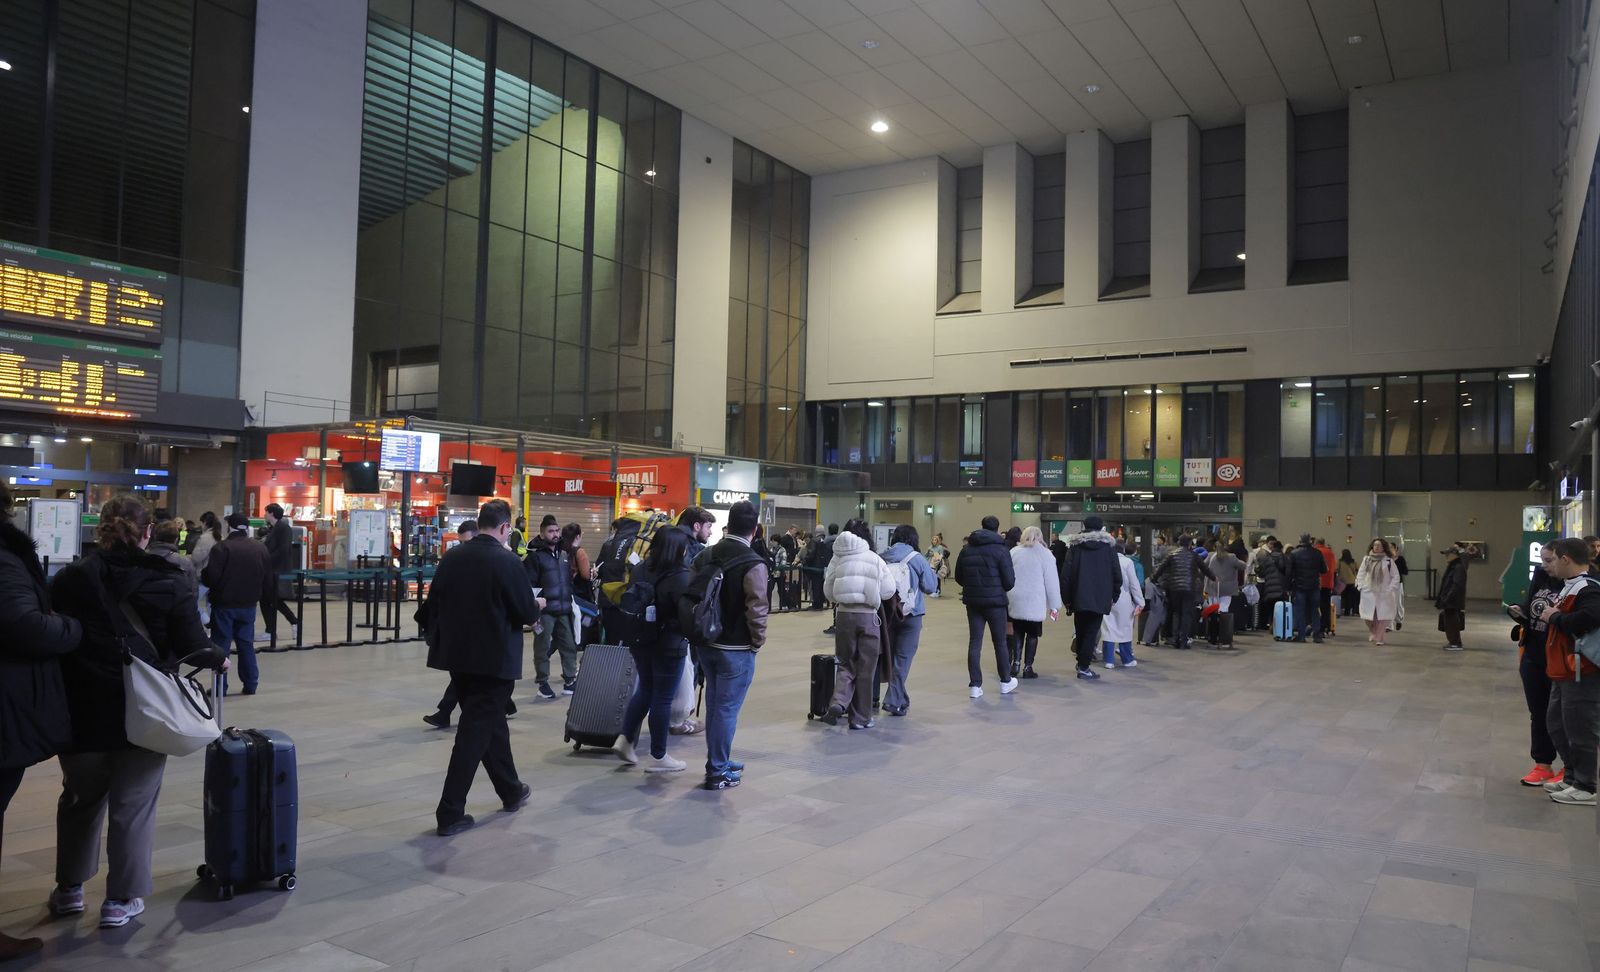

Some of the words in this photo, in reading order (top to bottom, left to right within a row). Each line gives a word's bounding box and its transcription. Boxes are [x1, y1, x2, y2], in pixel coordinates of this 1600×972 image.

[565, 479, 584, 493] RELAY
[713, 490, 750, 504] CHANGE
[1218, 505, 1229, 513] P1
